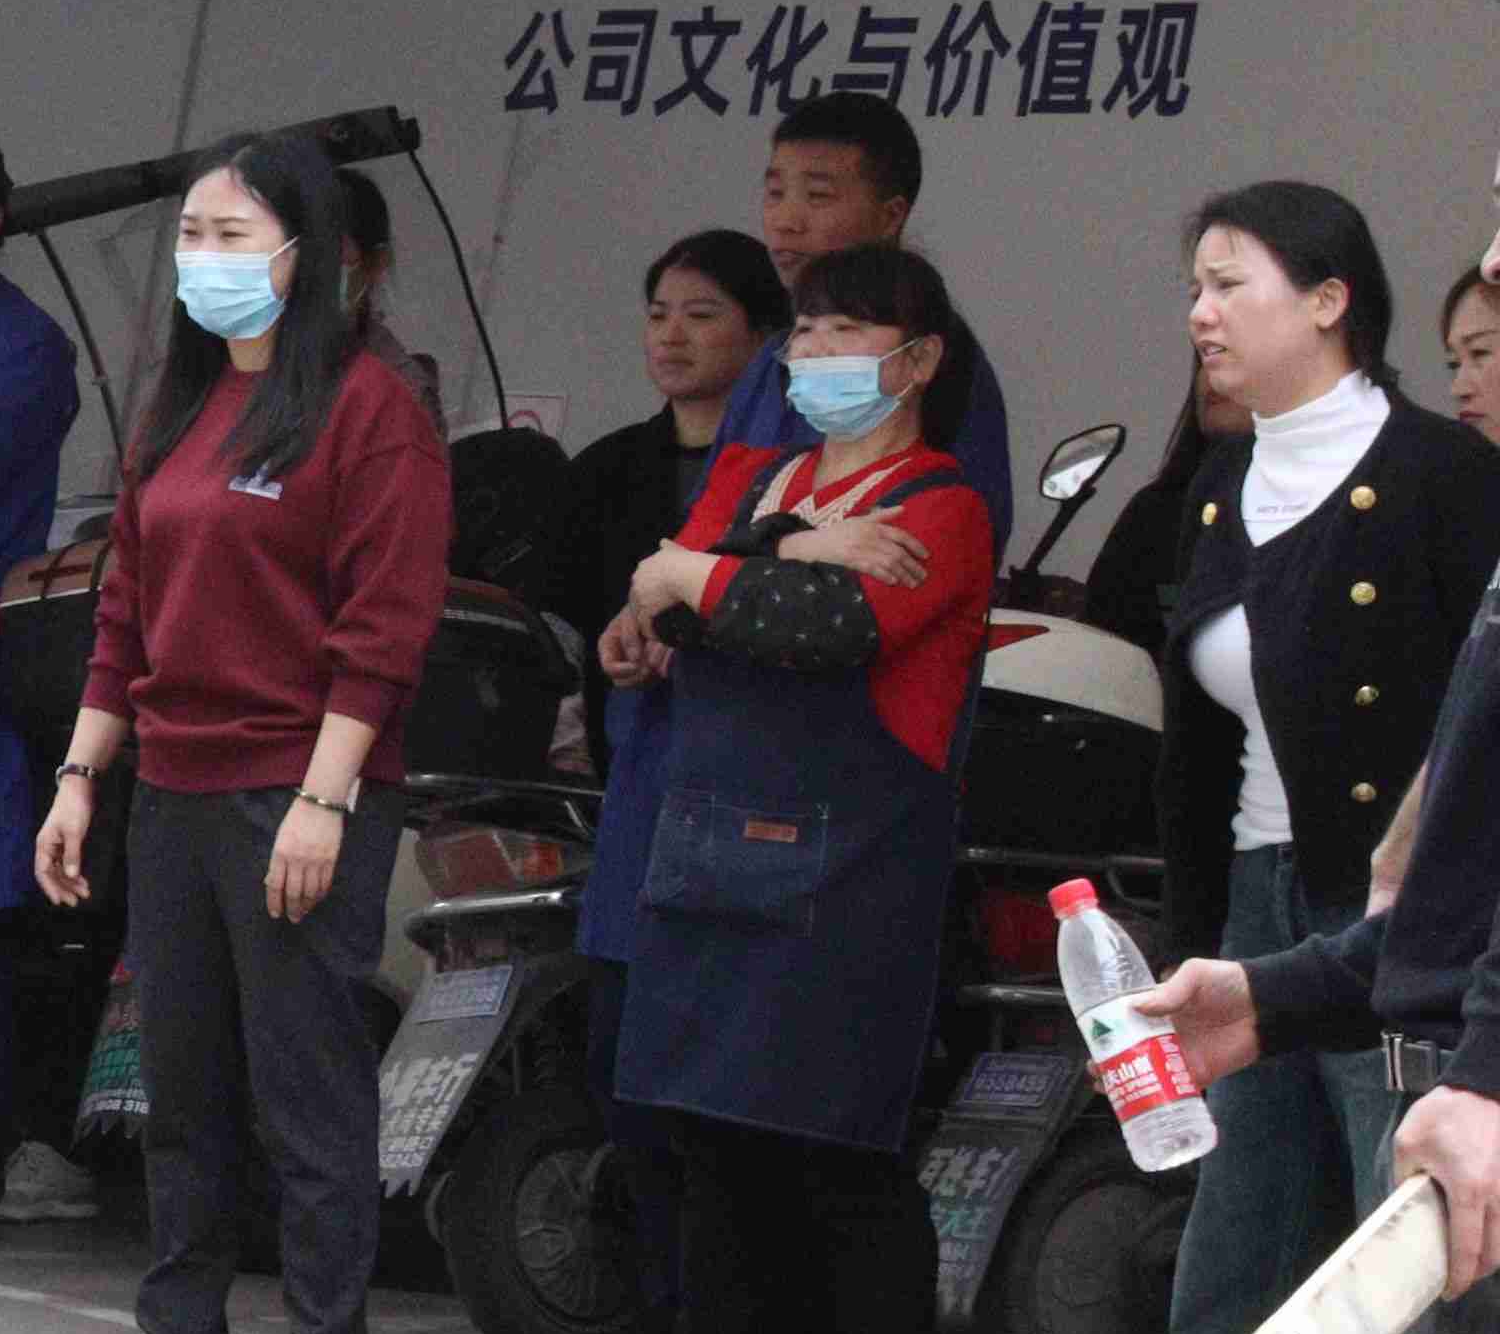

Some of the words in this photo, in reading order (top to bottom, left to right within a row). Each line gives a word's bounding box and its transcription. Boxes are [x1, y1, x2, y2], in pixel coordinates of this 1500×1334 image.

[504, 0, 1199, 119] 公司文化与价值观
